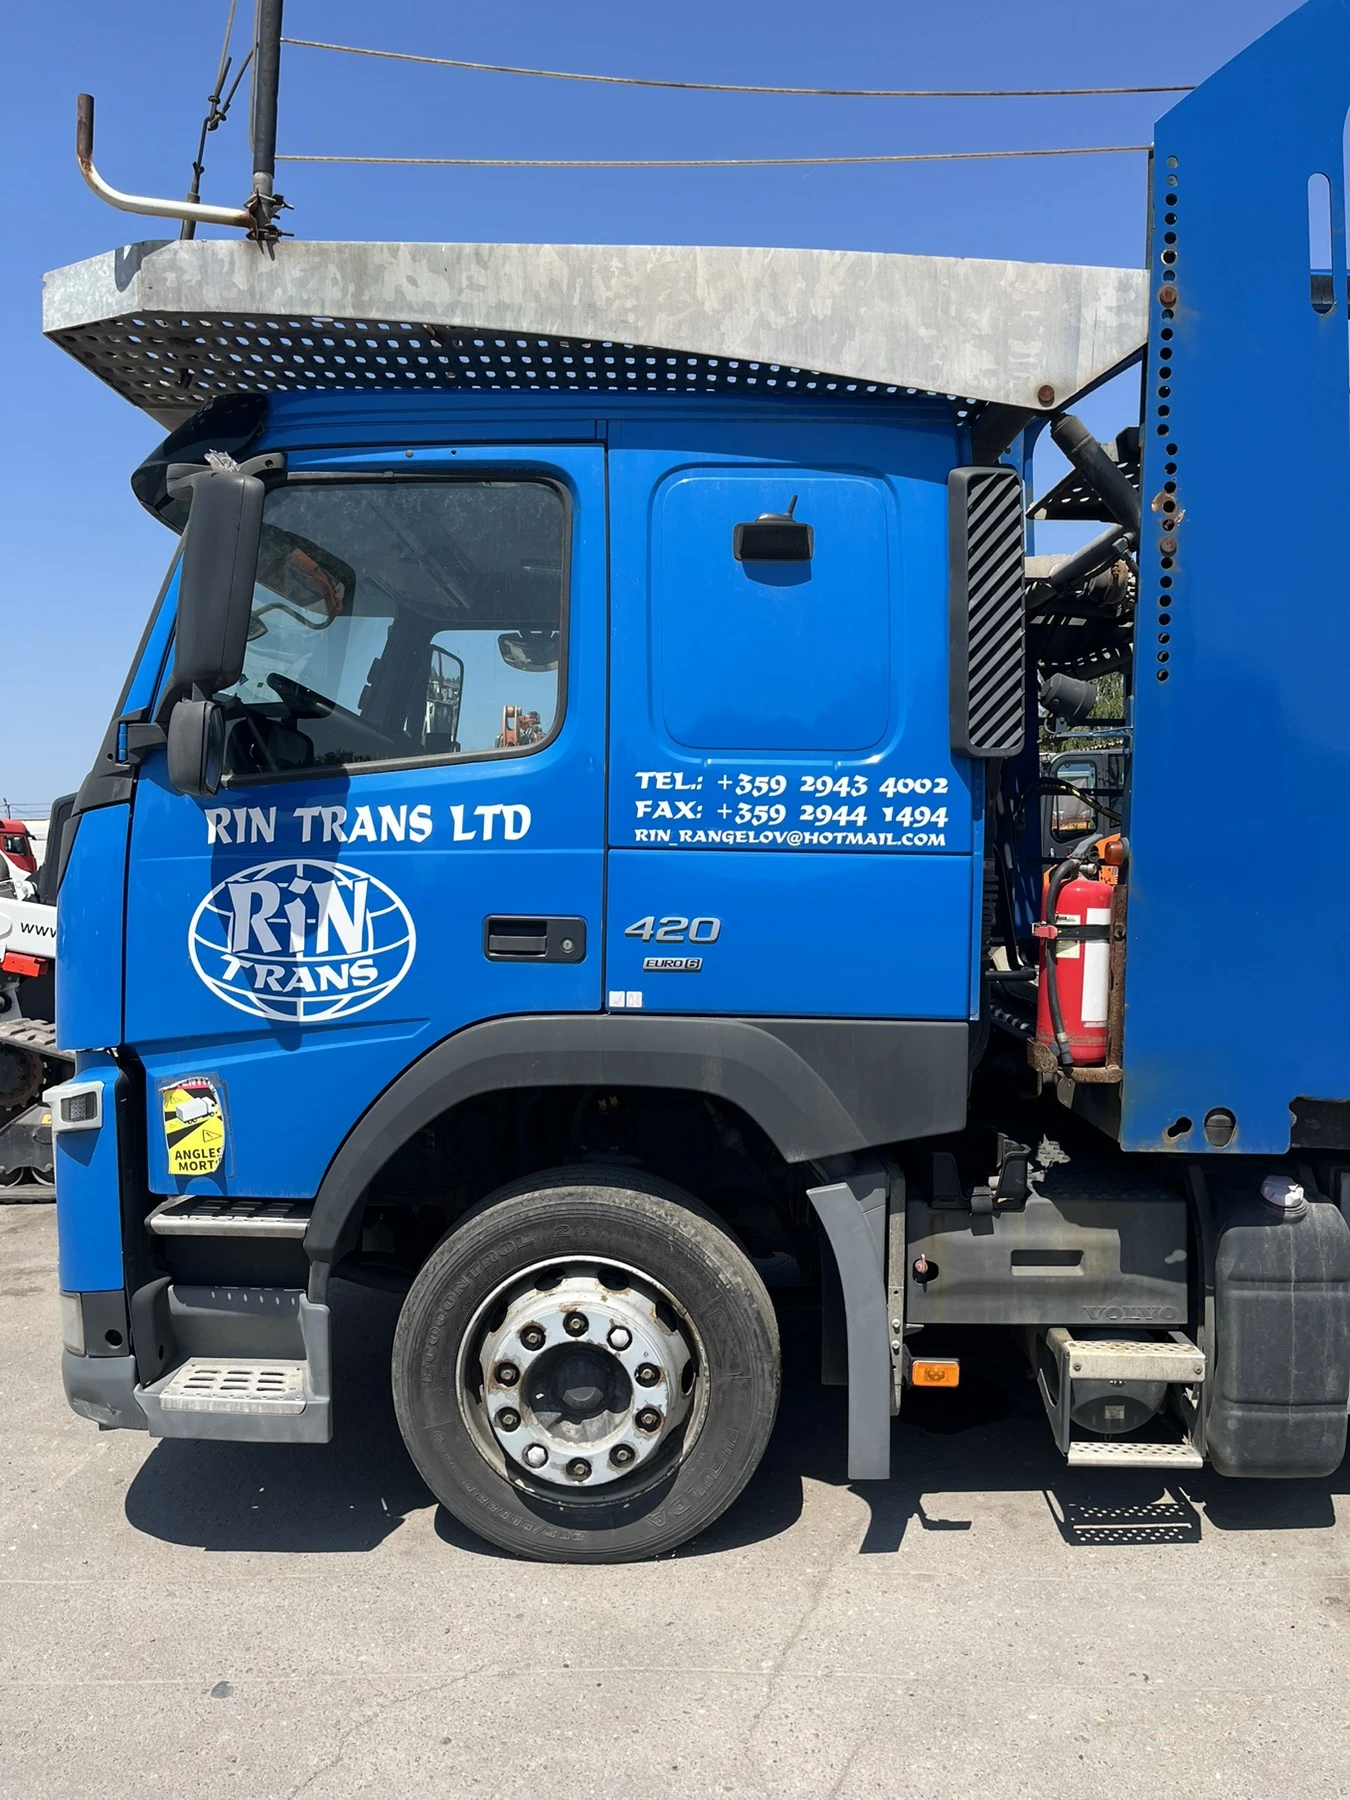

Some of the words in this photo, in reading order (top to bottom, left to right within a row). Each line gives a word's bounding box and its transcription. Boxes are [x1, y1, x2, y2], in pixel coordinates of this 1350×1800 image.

[635, 771, 703, 790] TEL.:
[717, 773, 787, 798] +359
[800, 775, 868, 797] 2943
[879, 777, 949, 798] 4002
[204, 806, 277, 844] RIN
[293, 804, 433, 844] TRANS
[450, 804, 532, 842] LTD
[635, 800, 703, 819] FAX:
[717, 802, 786, 826] +359
[799, 804, 867, 826] 2944
[881, 806, 949, 828] 1494
[634, 829, 946, 847] RIN_RANGELOV@HOTMAIL.COM
[624, 916, 721, 944] 420
[220, 954, 379, 993] TRANS
[646, 959, 683, 968] EURO
[684, 959, 700, 969] 6
[178, 1159, 218, 1171] MORT
[1082, 1305, 1178, 1320] VOLVO
